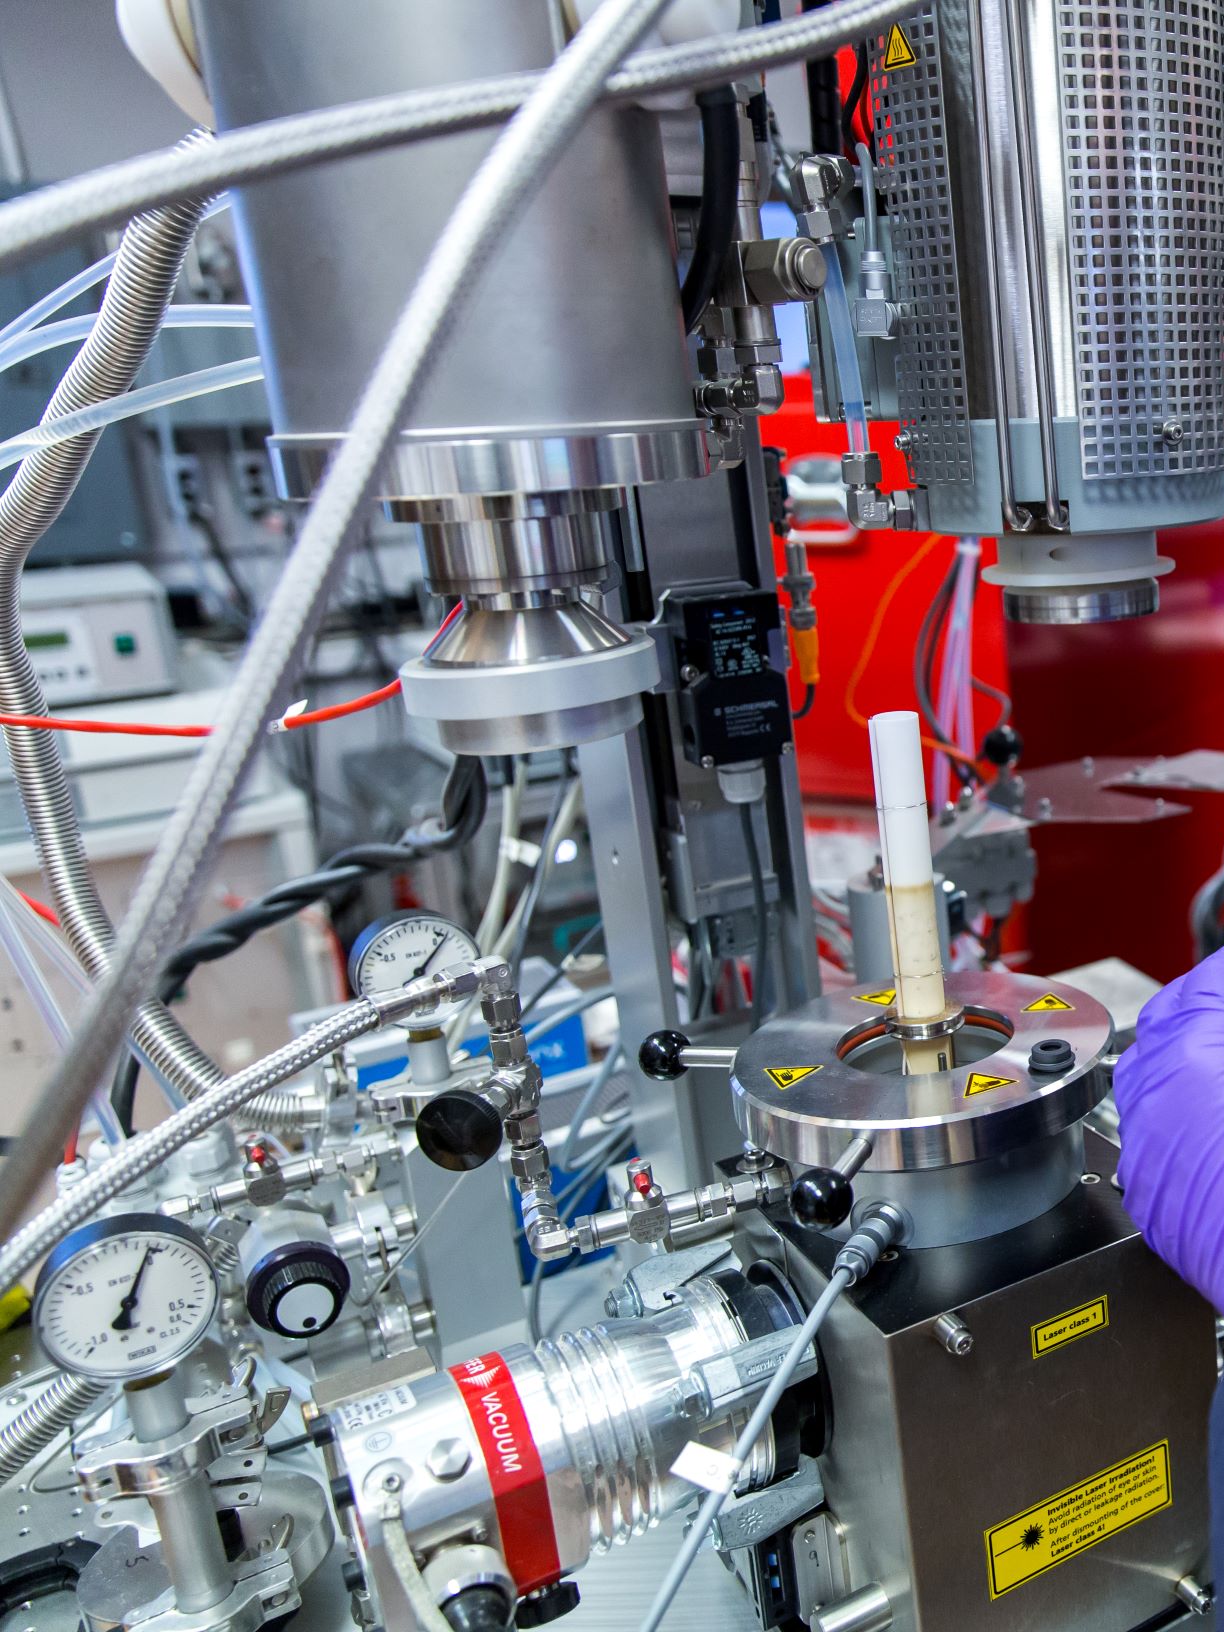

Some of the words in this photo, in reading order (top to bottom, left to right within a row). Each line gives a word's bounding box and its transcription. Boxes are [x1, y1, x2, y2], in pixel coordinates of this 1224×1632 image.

[169, 1298, 185, 1312] 0.5
[1043, 1326, 1067, 1341] Laser
[1069, 1316, 1090, 1330] class
[480, 1391, 523, 1473] VACUUM
[1047, 1493, 1083, 1516] Invisible
[1085, 1482, 1107, 1496] Laser
[1109, 1456, 1155, 1484] Irradiation!
[1048, 1509, 1071, 1525] Avoid
[1072, 1491, 1107, 1513] radiation
[1108, 1485, 1117, 1494] of
[1118, 1478, 1131, 1489] eye
[1133, 1473, 1141, 1481] or
[1142, 1465, 1157, 1477] skin
[1049, 1527, 1058, 1535] by
[1060, 1513, 1082, 1529] direct
[1084, 1508, 1092, 1516] or
[1094, 1492, 1123, 1510] leakage
[1124, 1473, 1160, 1496] radiation.
[1050, 1532, 1070, 1548] After
[1072, 1508, 1119, 1537] dismounting
[1120, 1500, 1129, 1511] of
[1130, 1495, 1142, 1506] the
[1051, 1541, 1074, 1557] Laser
[1075, 1530, 1096, 1544] class
[1096, 1523, 1105, 1532] 4!
